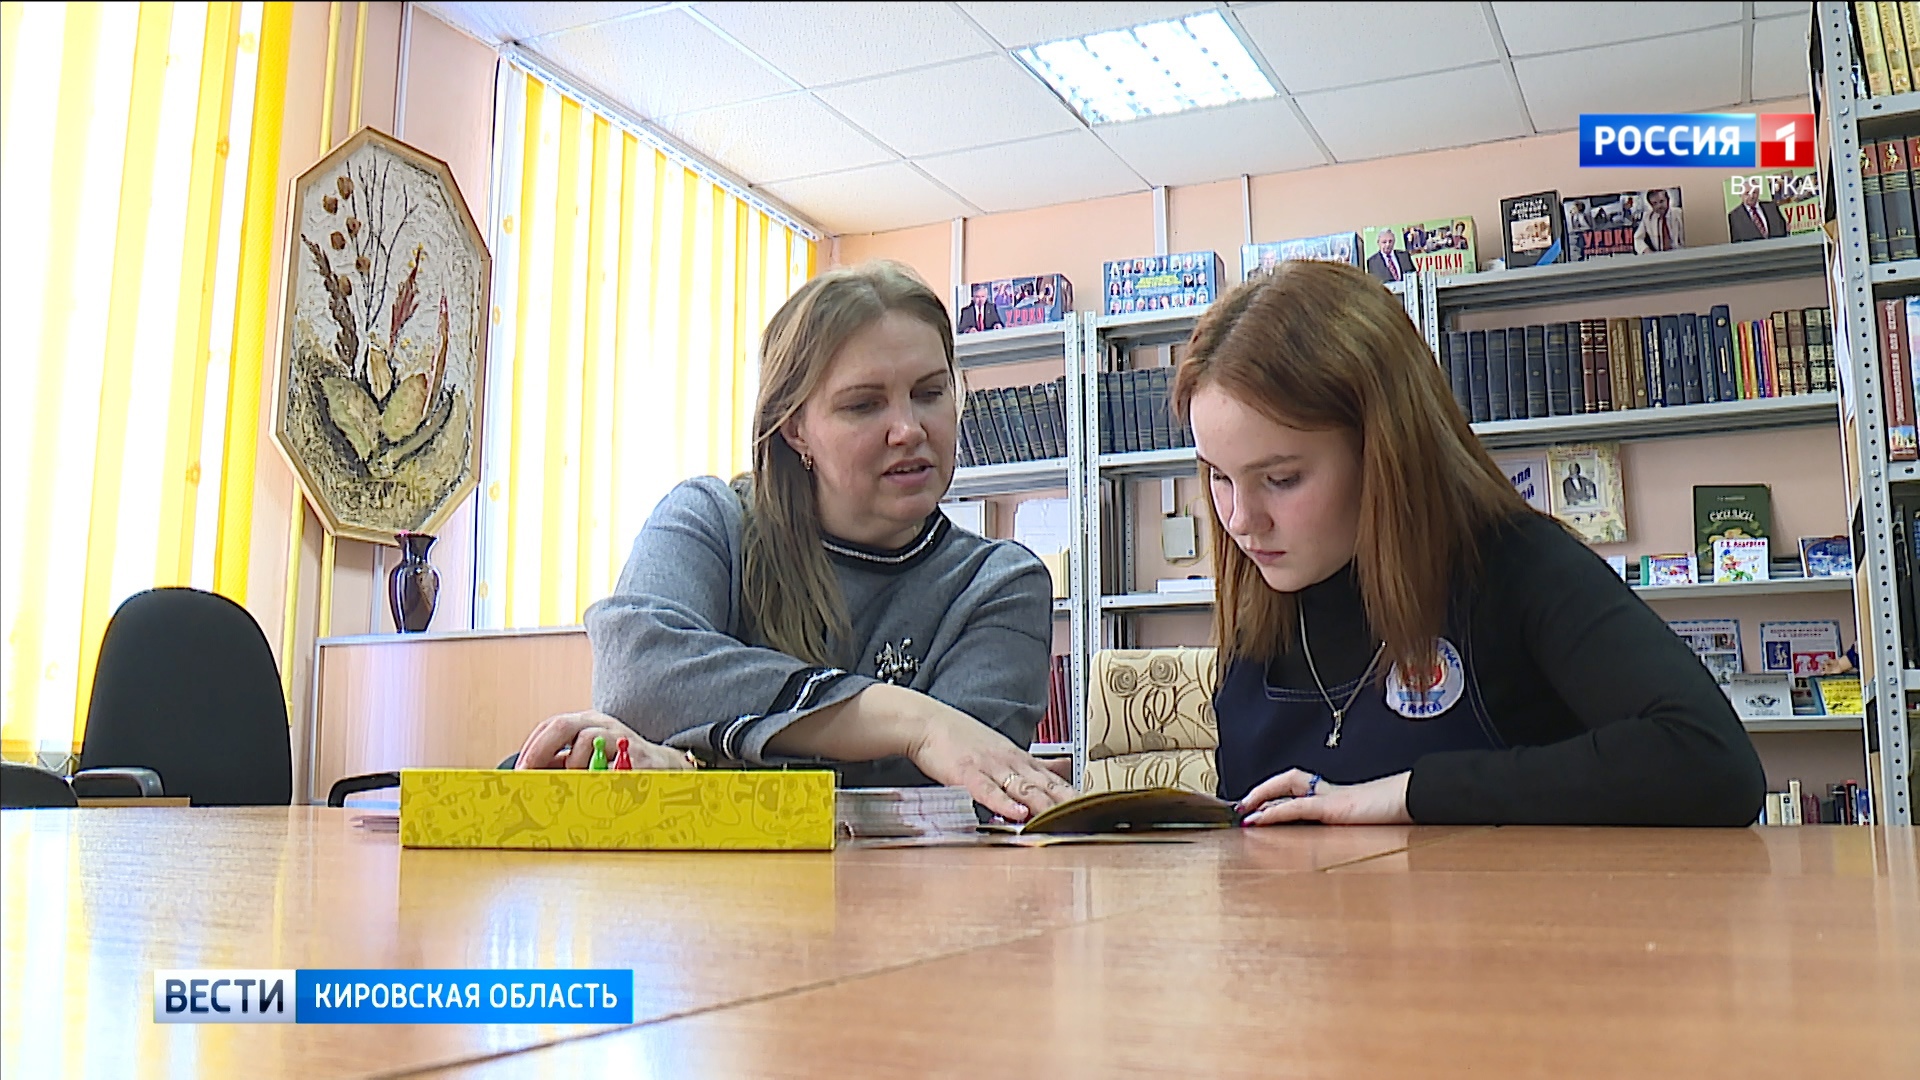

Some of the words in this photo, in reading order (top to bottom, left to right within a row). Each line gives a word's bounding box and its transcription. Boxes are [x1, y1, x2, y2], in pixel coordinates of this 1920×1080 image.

[1784, 202, 1822, 225] УРО
[1583, 228, 1633, 248] УРОКИ
[1415, 253, 1463, 272] УРОКИ
[1005, 307, 1045, 326] УРОКИ
